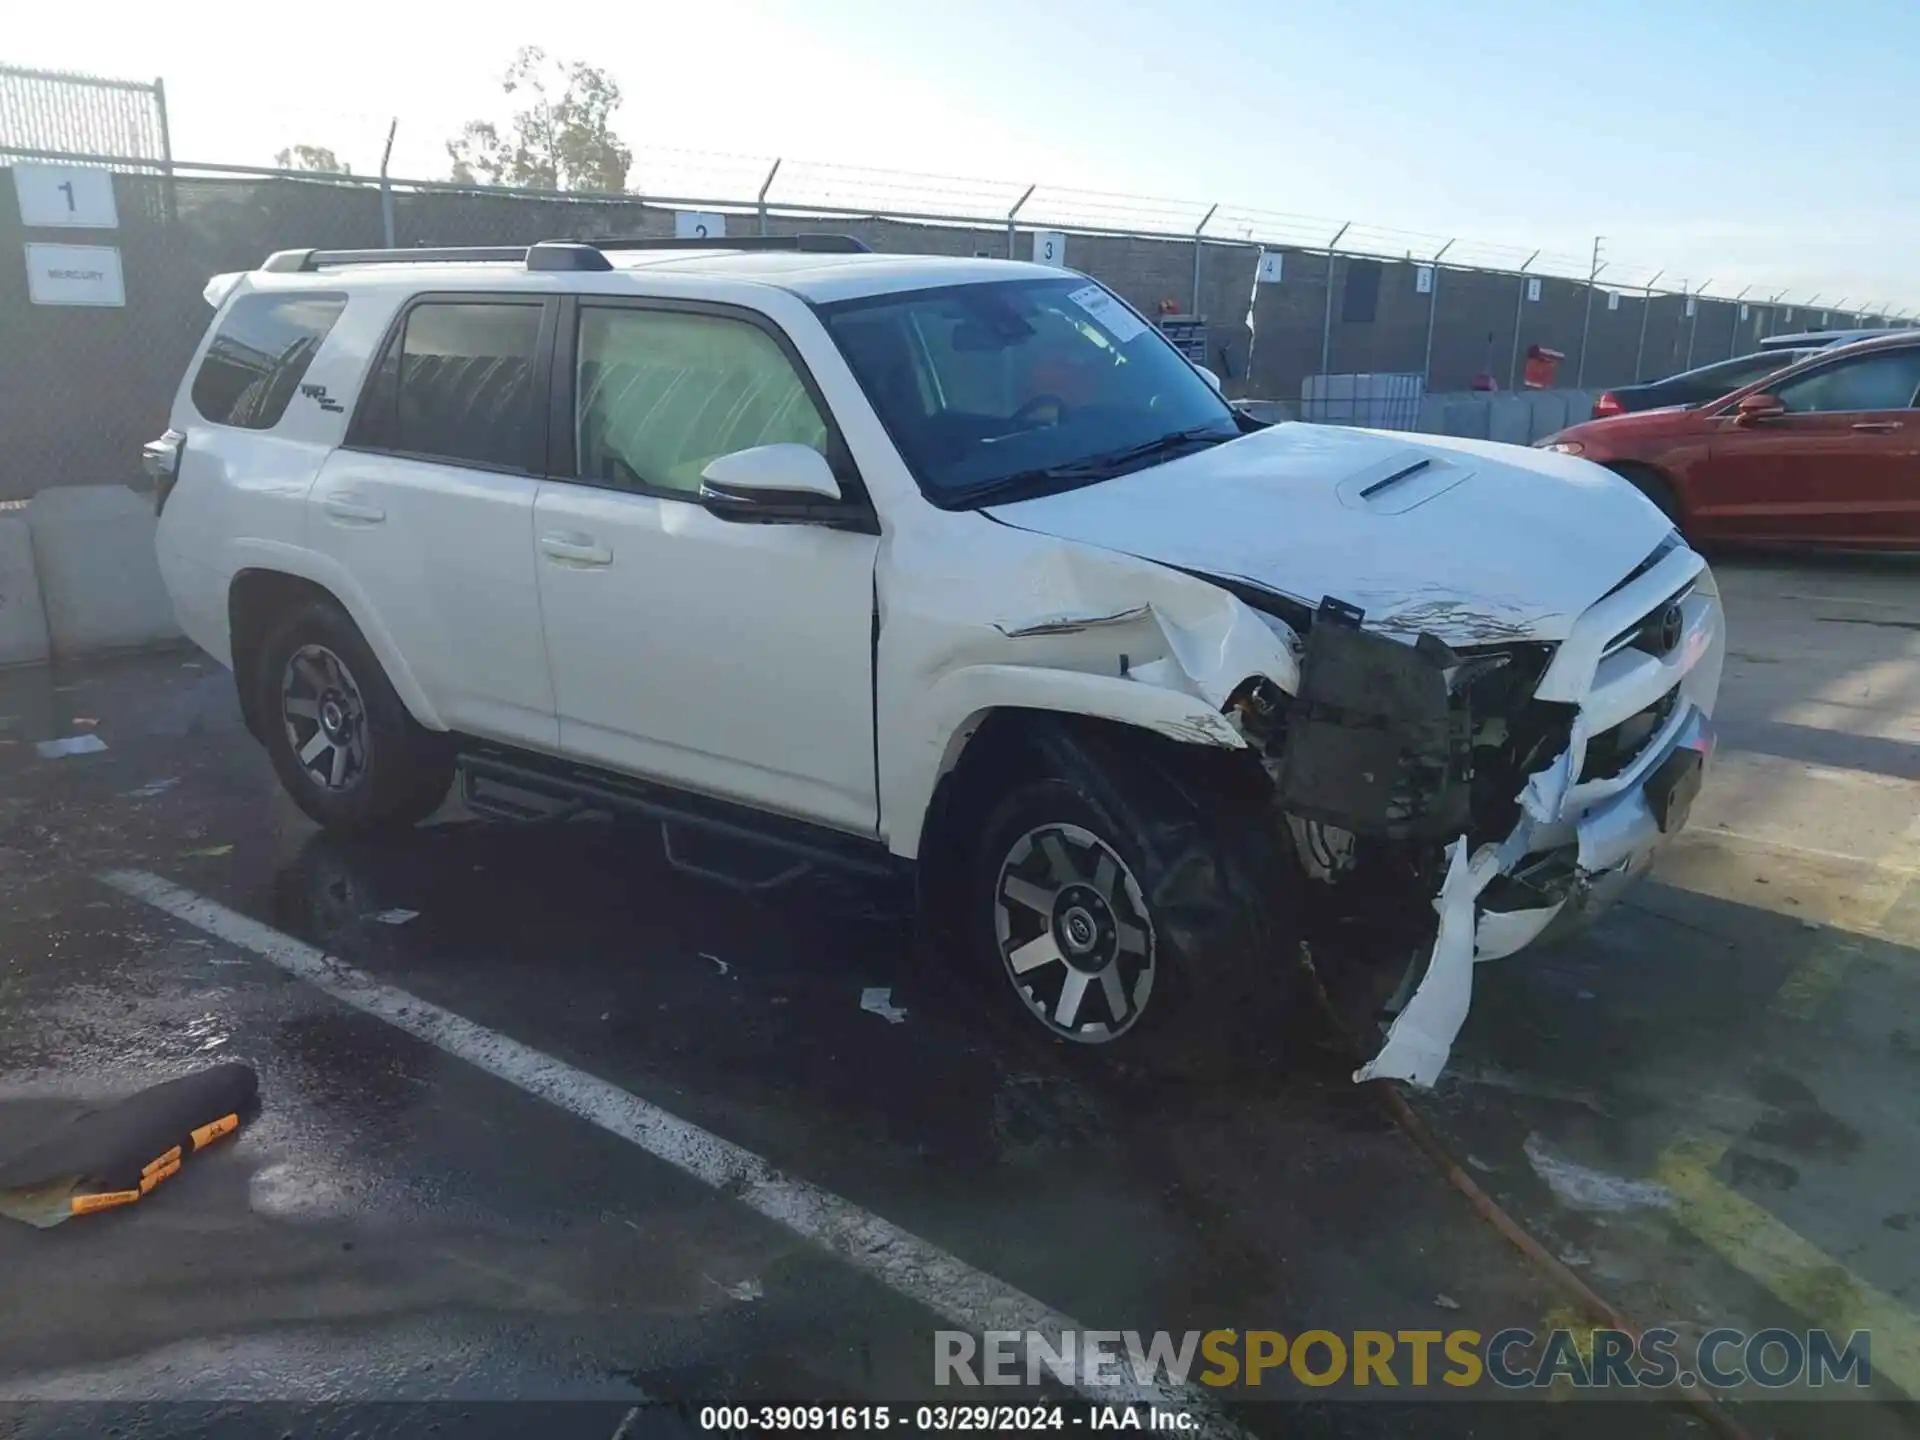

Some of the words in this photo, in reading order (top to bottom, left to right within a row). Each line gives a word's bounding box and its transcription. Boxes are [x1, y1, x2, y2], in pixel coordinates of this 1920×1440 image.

[58, 181, 76, 212] 1
[1044, 241, 1053, 260] 3
[47, 269, 104, 281] MERCURY
